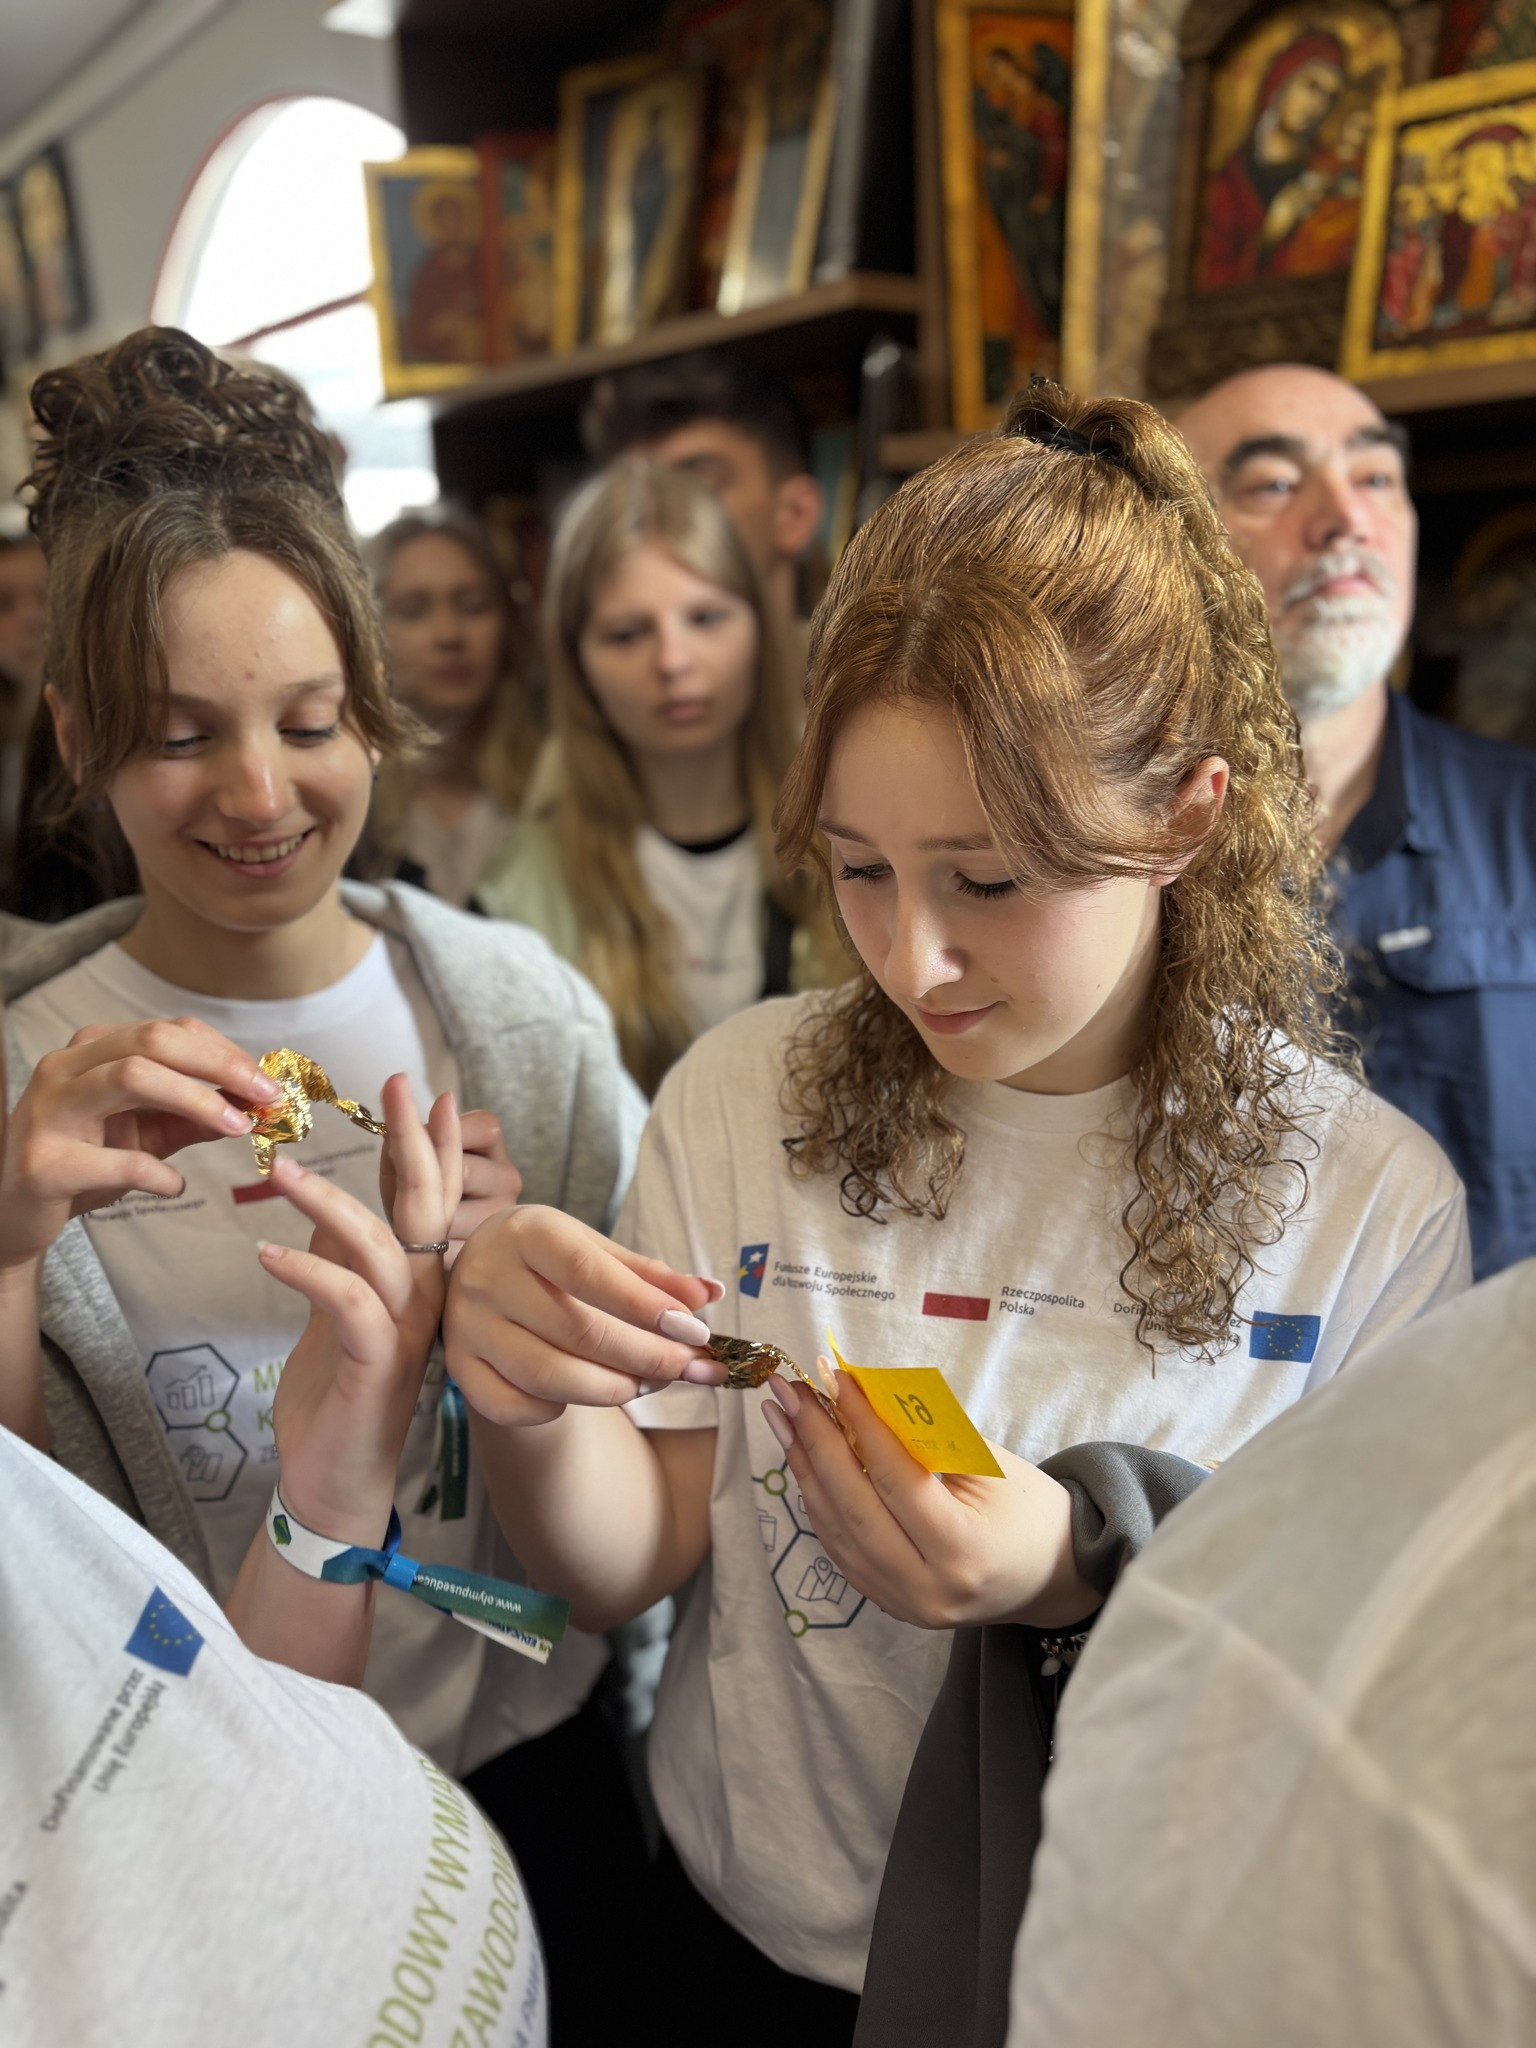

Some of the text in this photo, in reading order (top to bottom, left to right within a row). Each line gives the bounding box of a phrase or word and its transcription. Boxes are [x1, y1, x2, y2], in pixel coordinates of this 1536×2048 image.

[814, 1266, 877, 1284] Europejskie
[825, 1283, 896, 1301] Społecznego
[1001, 1286, 1085, 1309] Rzeczpospolita
[999, 1301, 1035, 1316] Polska
[414, 1574, 523, 1614] www.olympuseduca
